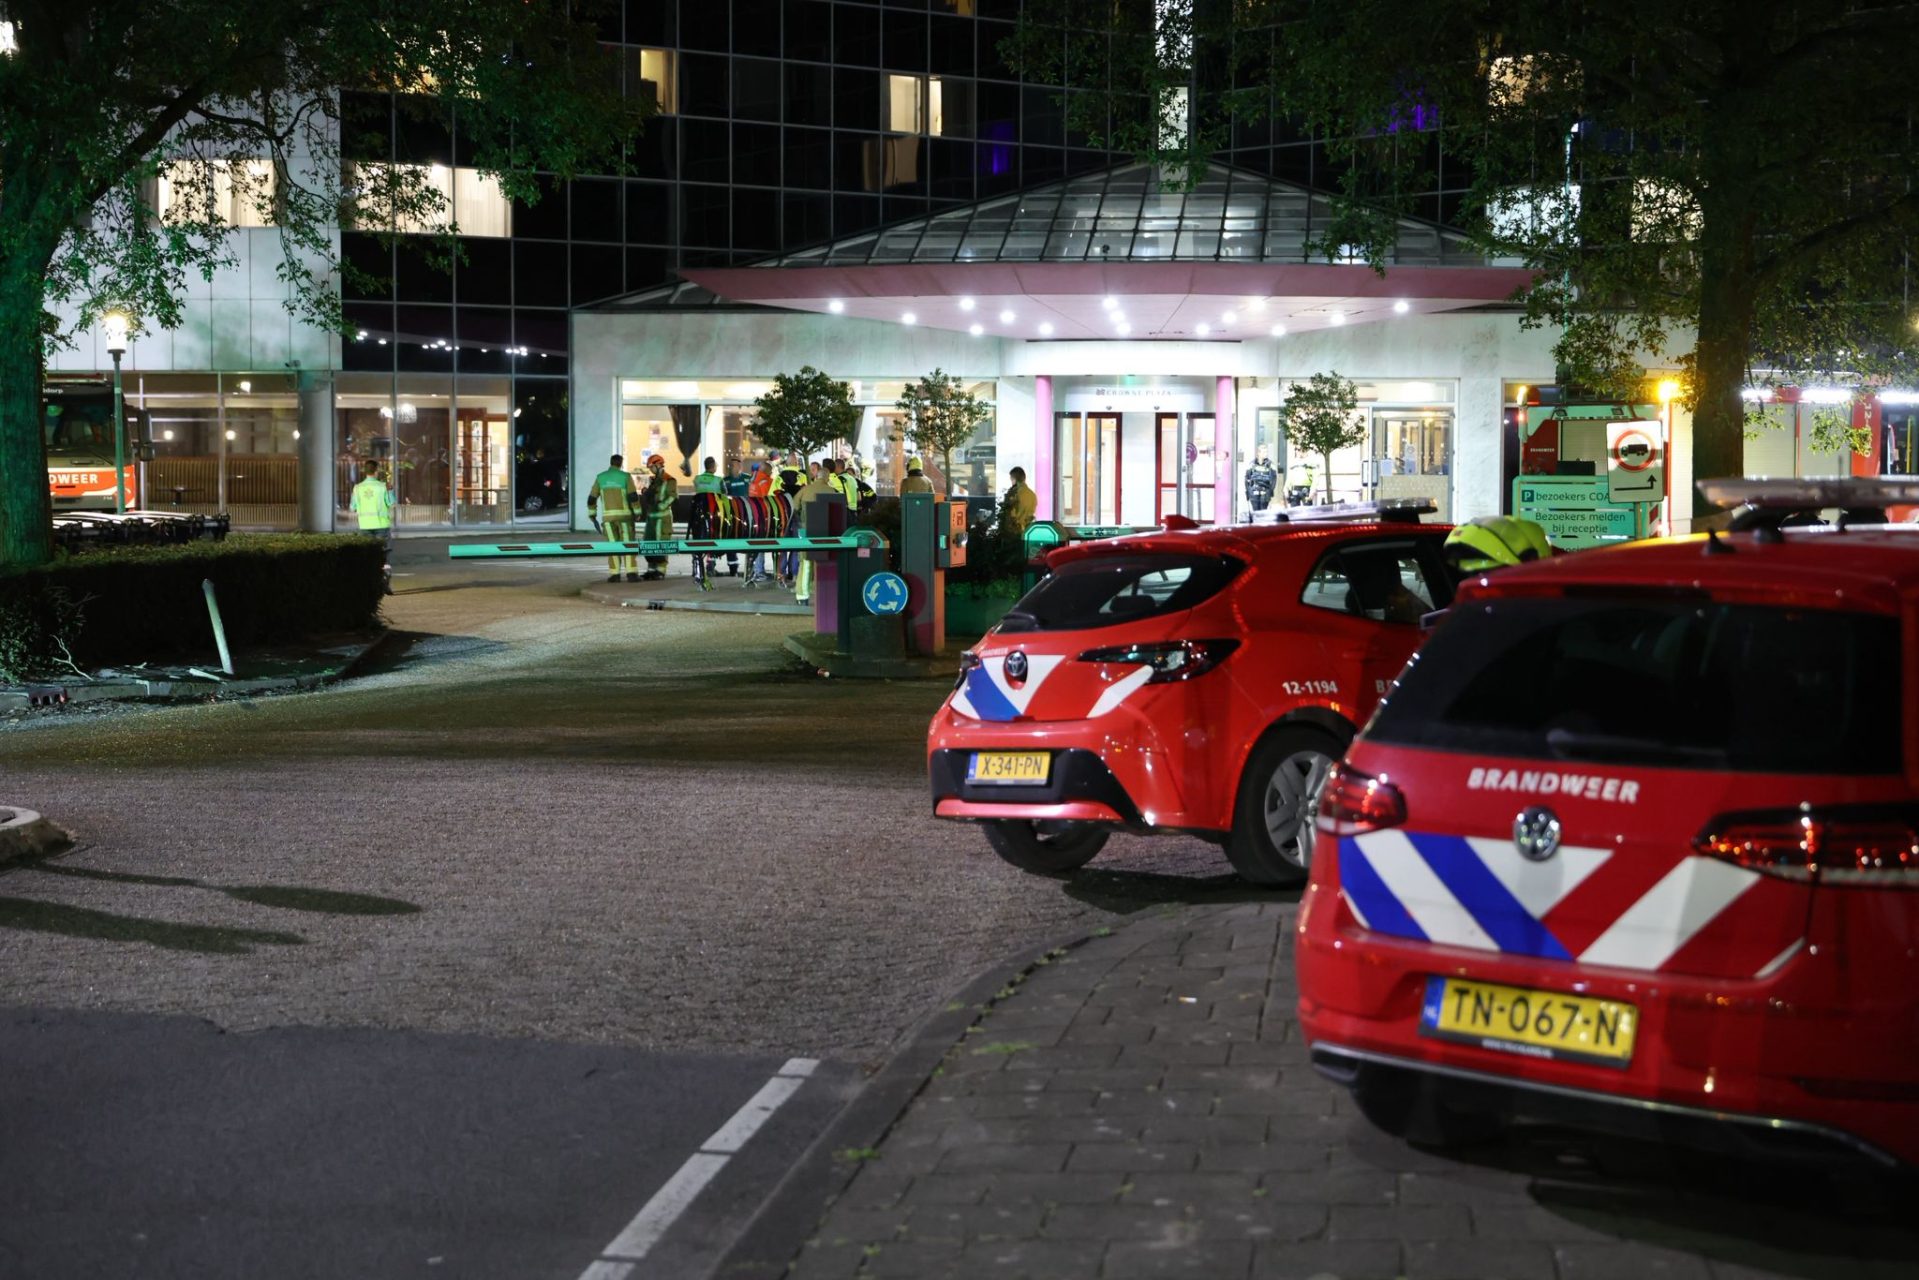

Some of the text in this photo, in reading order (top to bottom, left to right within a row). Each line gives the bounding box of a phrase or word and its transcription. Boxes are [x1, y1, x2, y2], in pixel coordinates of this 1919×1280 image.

[49, 473, 98, 484] DWEER
[1536, 492, 1586, 501] bezoekers
[1535, 512, 1626, 521] Bezoekers melden
[1552, 524, 1608, 535] bij receptie
[1282, 680, 1338, 695] 12-1194
[982, 755, 1042, 776] X-341-PN
[1452, 986, 1619, 1046] TN-067-N
